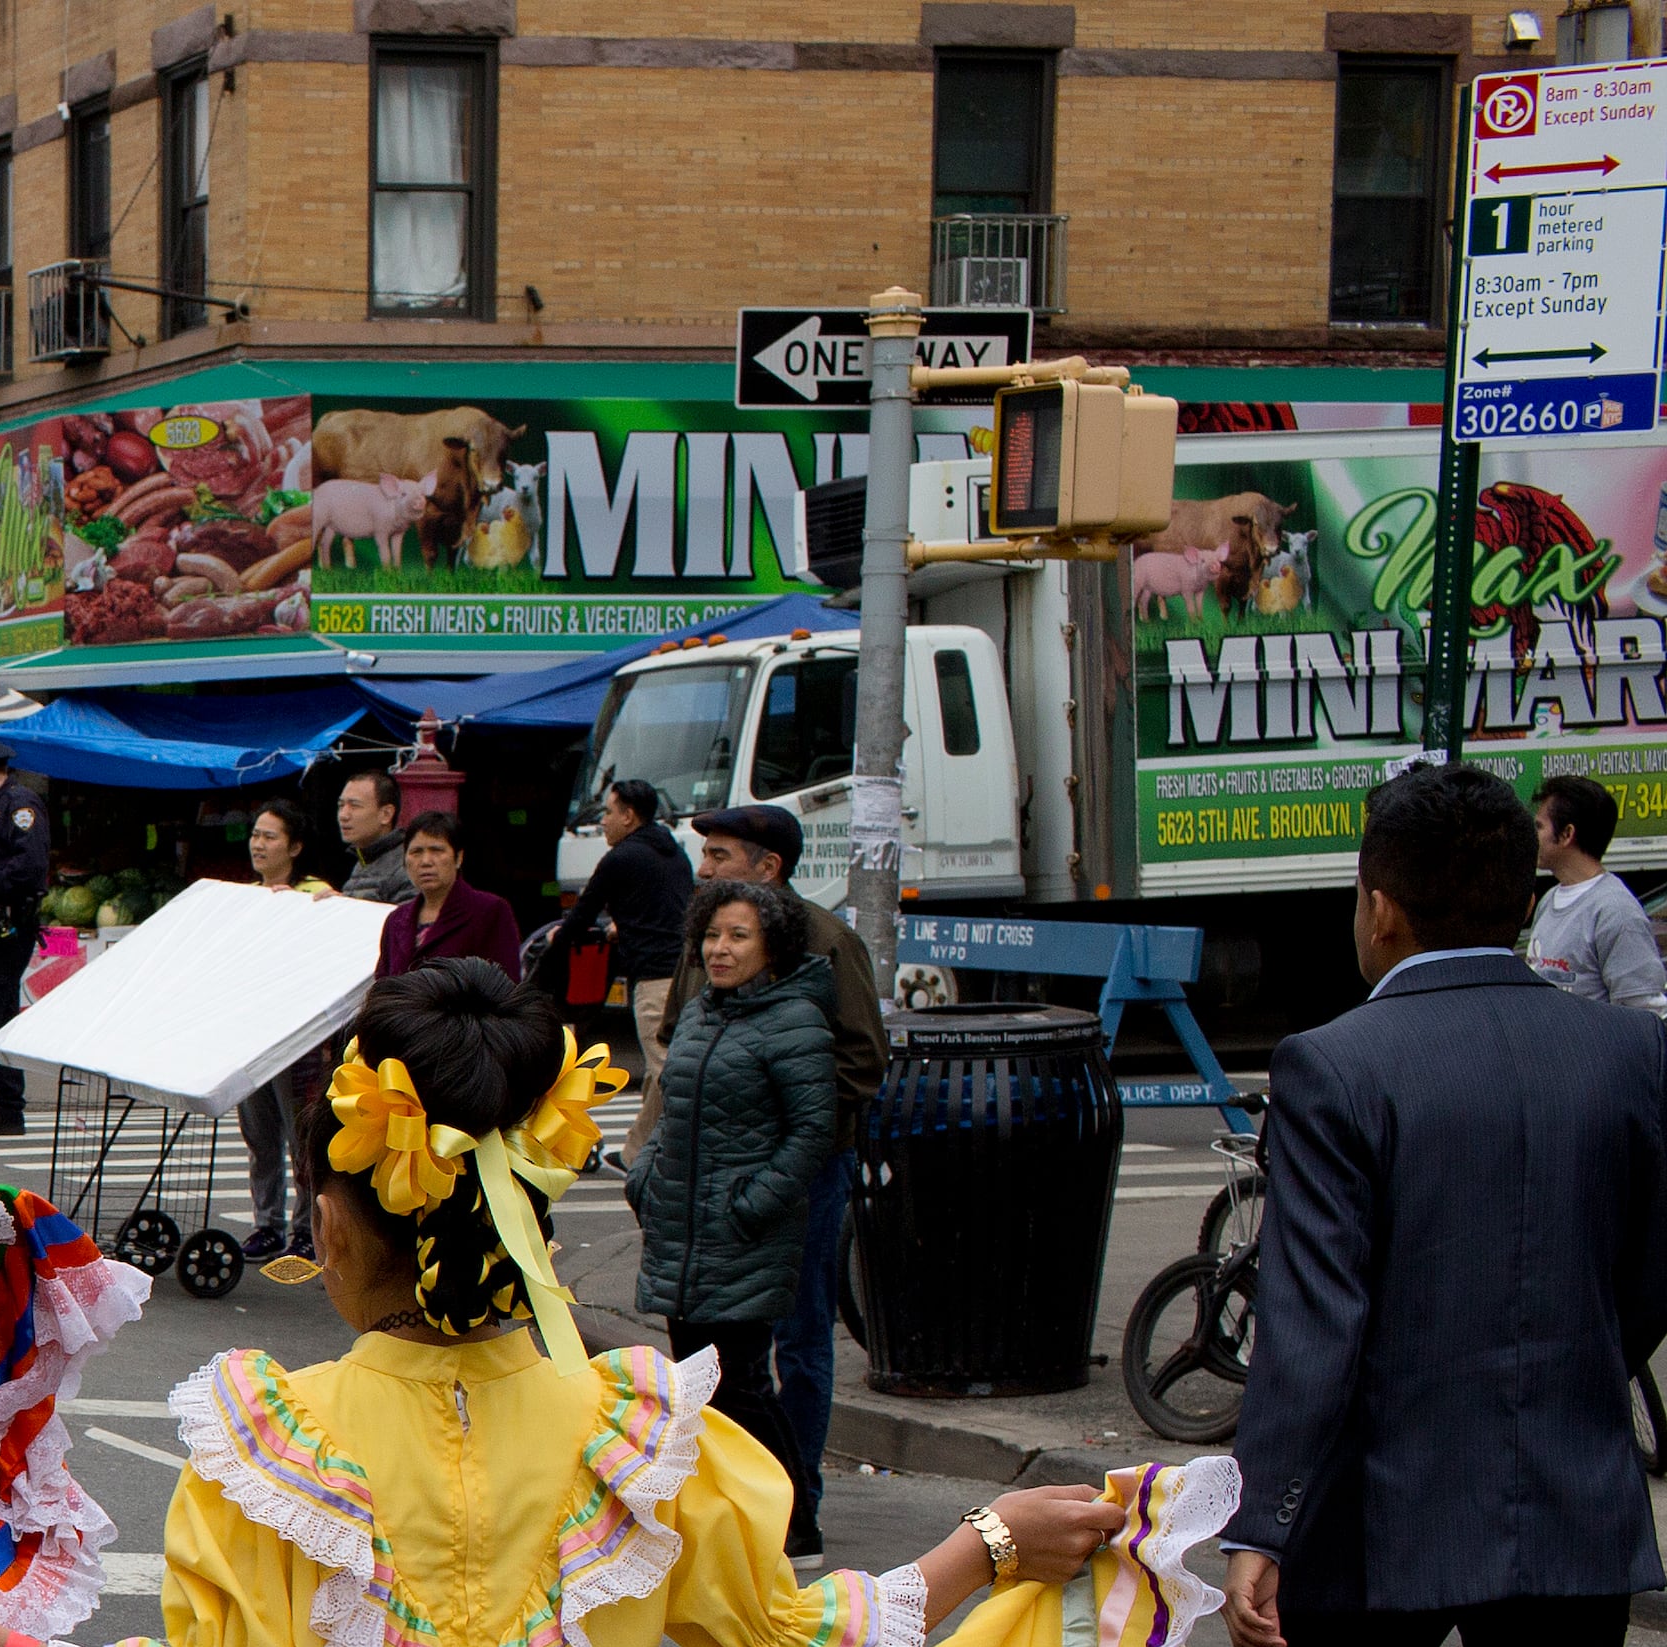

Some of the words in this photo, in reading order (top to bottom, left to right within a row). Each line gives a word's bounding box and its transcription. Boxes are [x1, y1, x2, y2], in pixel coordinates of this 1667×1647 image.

[1545, 86, 1579, 103] 8am
[1594, 80, 1652, 99] 8:30am
[1544, 107, 1595, 127] Except
[1600, 102, 1656, 122] Sunday
[1539, 202, 1574, 217] hour
[1491, 202, 1510, 251] 1
[1538, 217, 1603, 235] metered
[1537, 236, 1595, 256] parking
[1475, 275, 1542, 295] 8:30am
[1562, 272, 1599, 293] 7pm
[1474, 298, 1535, 319] Except
[1540, 295, 1608, 316] Sunday
[784, 340, 864, 376] ONE
[1463, 385, 1513, 400] Zone#
[1460, 399, 1578, 436] 302660
[166, 420, 201, 445] 5623
[1345, 486, 1623, 639] Max
[317, 605, 365, 634] 5623
[371, 605, 425, 634] FRESH
[430, 605, 486, 634] MEATS
[504, 605, 564, 634] FRUITS
[567, 606, 579, 634] &
[585, 605, 686, 634] VEGETABLES
[1165, 629, 1404, 745] MINI
[1542, 753, 1590, 778] BARBACOA
[1598, 750, 1630, 775] VENTAS
[1631, 750, 1643, 773] AL
[1156, 775, 1186, 799] FRESH
[1188, 772, 1218, 797] MEATS
[1225, 770, 1258, 795] FRUITS
[1261, 769, 1267, 793] &
[1269, 767, 1324, 793] VEGETABLES
[1332, 764, 1374, 790] GROCERY
[1605, 782, 1667, 821] 7-34
[816, 822, 851, 838] MARKE
[1157, 810, 1195, 846] 5623
[1198, 808, 1228, 844] 5TH
[1231, 806, 1266, 841] AVE.
[1270, 802, 1356, 840] BROOKLYN,
[816, 843, 849, 858] AVENU
[914, 921, 938, 940] LINE
[971, 924, 994, 944] NOT
[997, 925, 1035, 946] CROSS
[930, 945, 967, 960] NYPD
[942, 1032, 962, 1043] Park
[965, 1031, 1002, 1043] Business
[1118, 1085, 1160, 1101] OLICE
